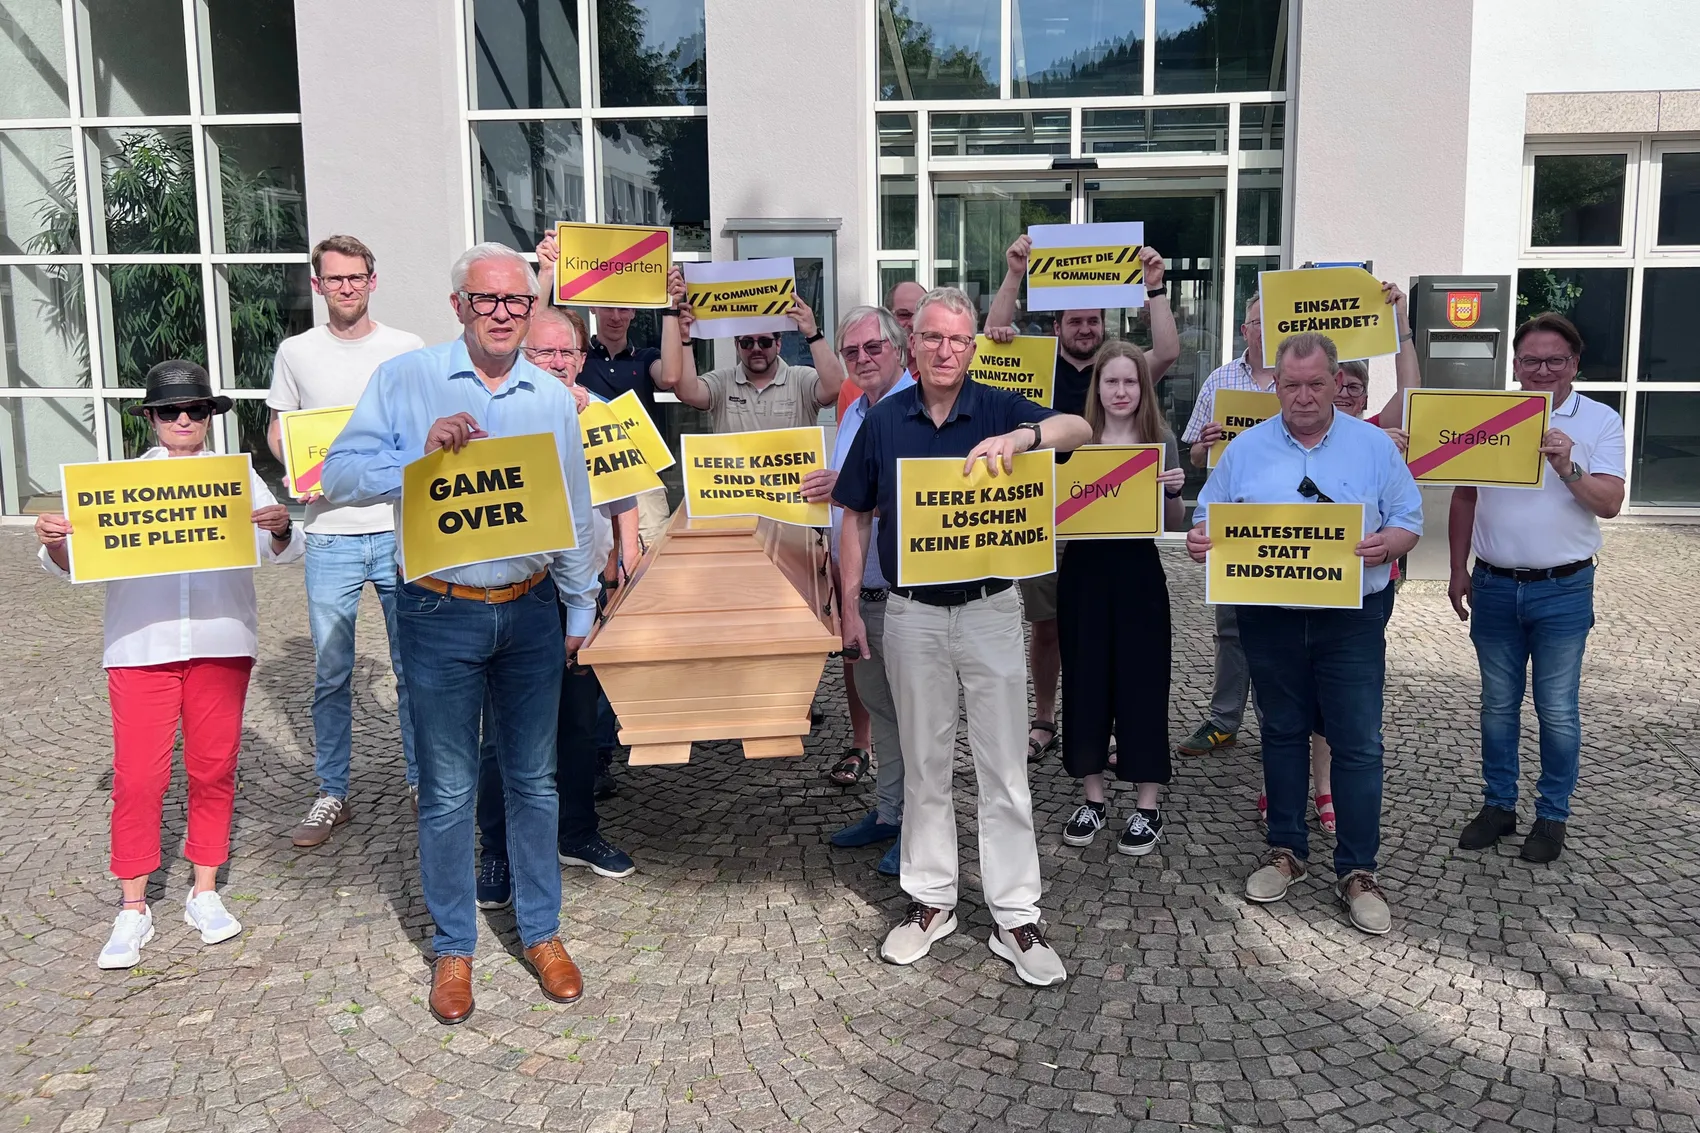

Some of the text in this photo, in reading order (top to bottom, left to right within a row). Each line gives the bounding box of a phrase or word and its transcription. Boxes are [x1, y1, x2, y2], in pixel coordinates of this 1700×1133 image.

[565, 256, 663, 276] Kindergarten
[1055, 252, 1114, 267] RETTET DIE
[1052, 271, 1120, 281] KOMMUNEN
[713, 284, 778, 302] KOMMUNEN
[710, 304, 759, 312] AM LIMIT
[1294, 297, 1360, 314] EINSATZ
[1277, 313, 1380, 333] GEFÄHRDET?
[979, 355, 1021, 368] WEGEN
[968, 369, 1034, 383] FINANZNOT
[1438, 429, 1511, 446] Straßen
[694, 451, 817, 469] LEERE KASSEN
[429, 465, 525, 502] GAME
[713, 472, 801, 487] SIND KEIN
[78, 481, 243, 507] DIE KOMMUNE
[915, 481, 1044, 507] LEERE KASSEN
[1070, 480, 1122, 499] ÖPNV
[98, 503, 228, 528] RUTSCHT IN
[438, 500, 529, 535] OVER
[941, 507, 1027, 529] LÖSCHEN
[104, 526, 227, 550] DIE PLEITE.
[910, 526, 1049, 553] KEINE BRÄNDE.
[1225, 526, 1345, 541] HALTESTELLE
[1258, 545, 1311, 560] STATT
[1226, 564, 1343, 581] ENDSTATION
